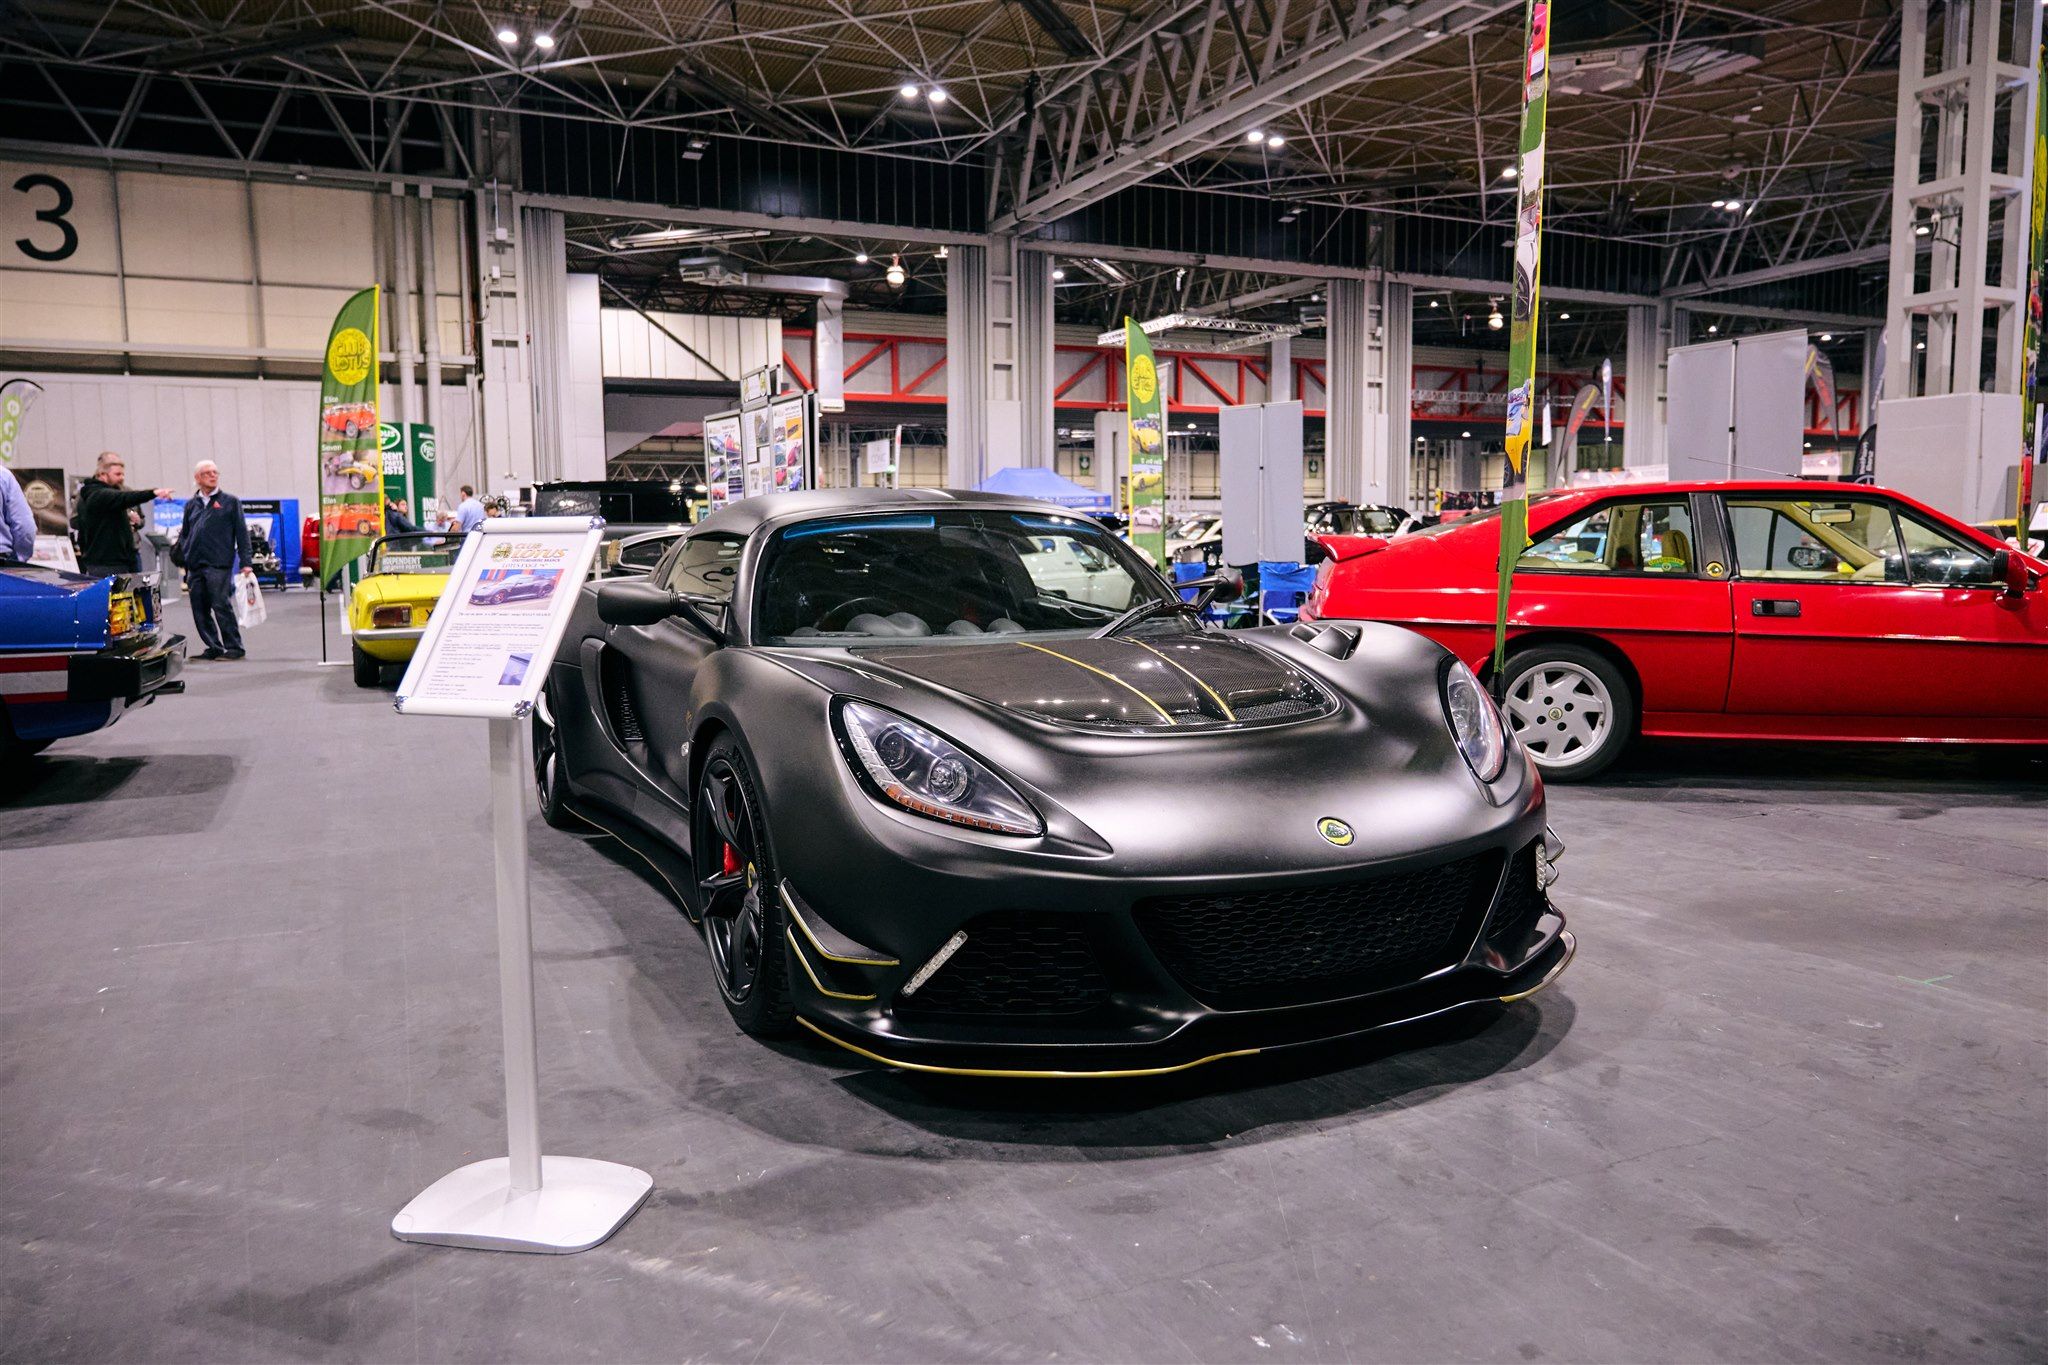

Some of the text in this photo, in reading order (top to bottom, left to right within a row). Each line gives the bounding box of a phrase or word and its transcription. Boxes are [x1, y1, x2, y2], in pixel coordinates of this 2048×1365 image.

[13, 173, 79, 262] 3
[336, 340, 366, 357] CLUB
[333, 355, 370, 372] LOTUS
[321, 443, 342, 451] Seven
[510, 548, 569, 559] LOTUS
